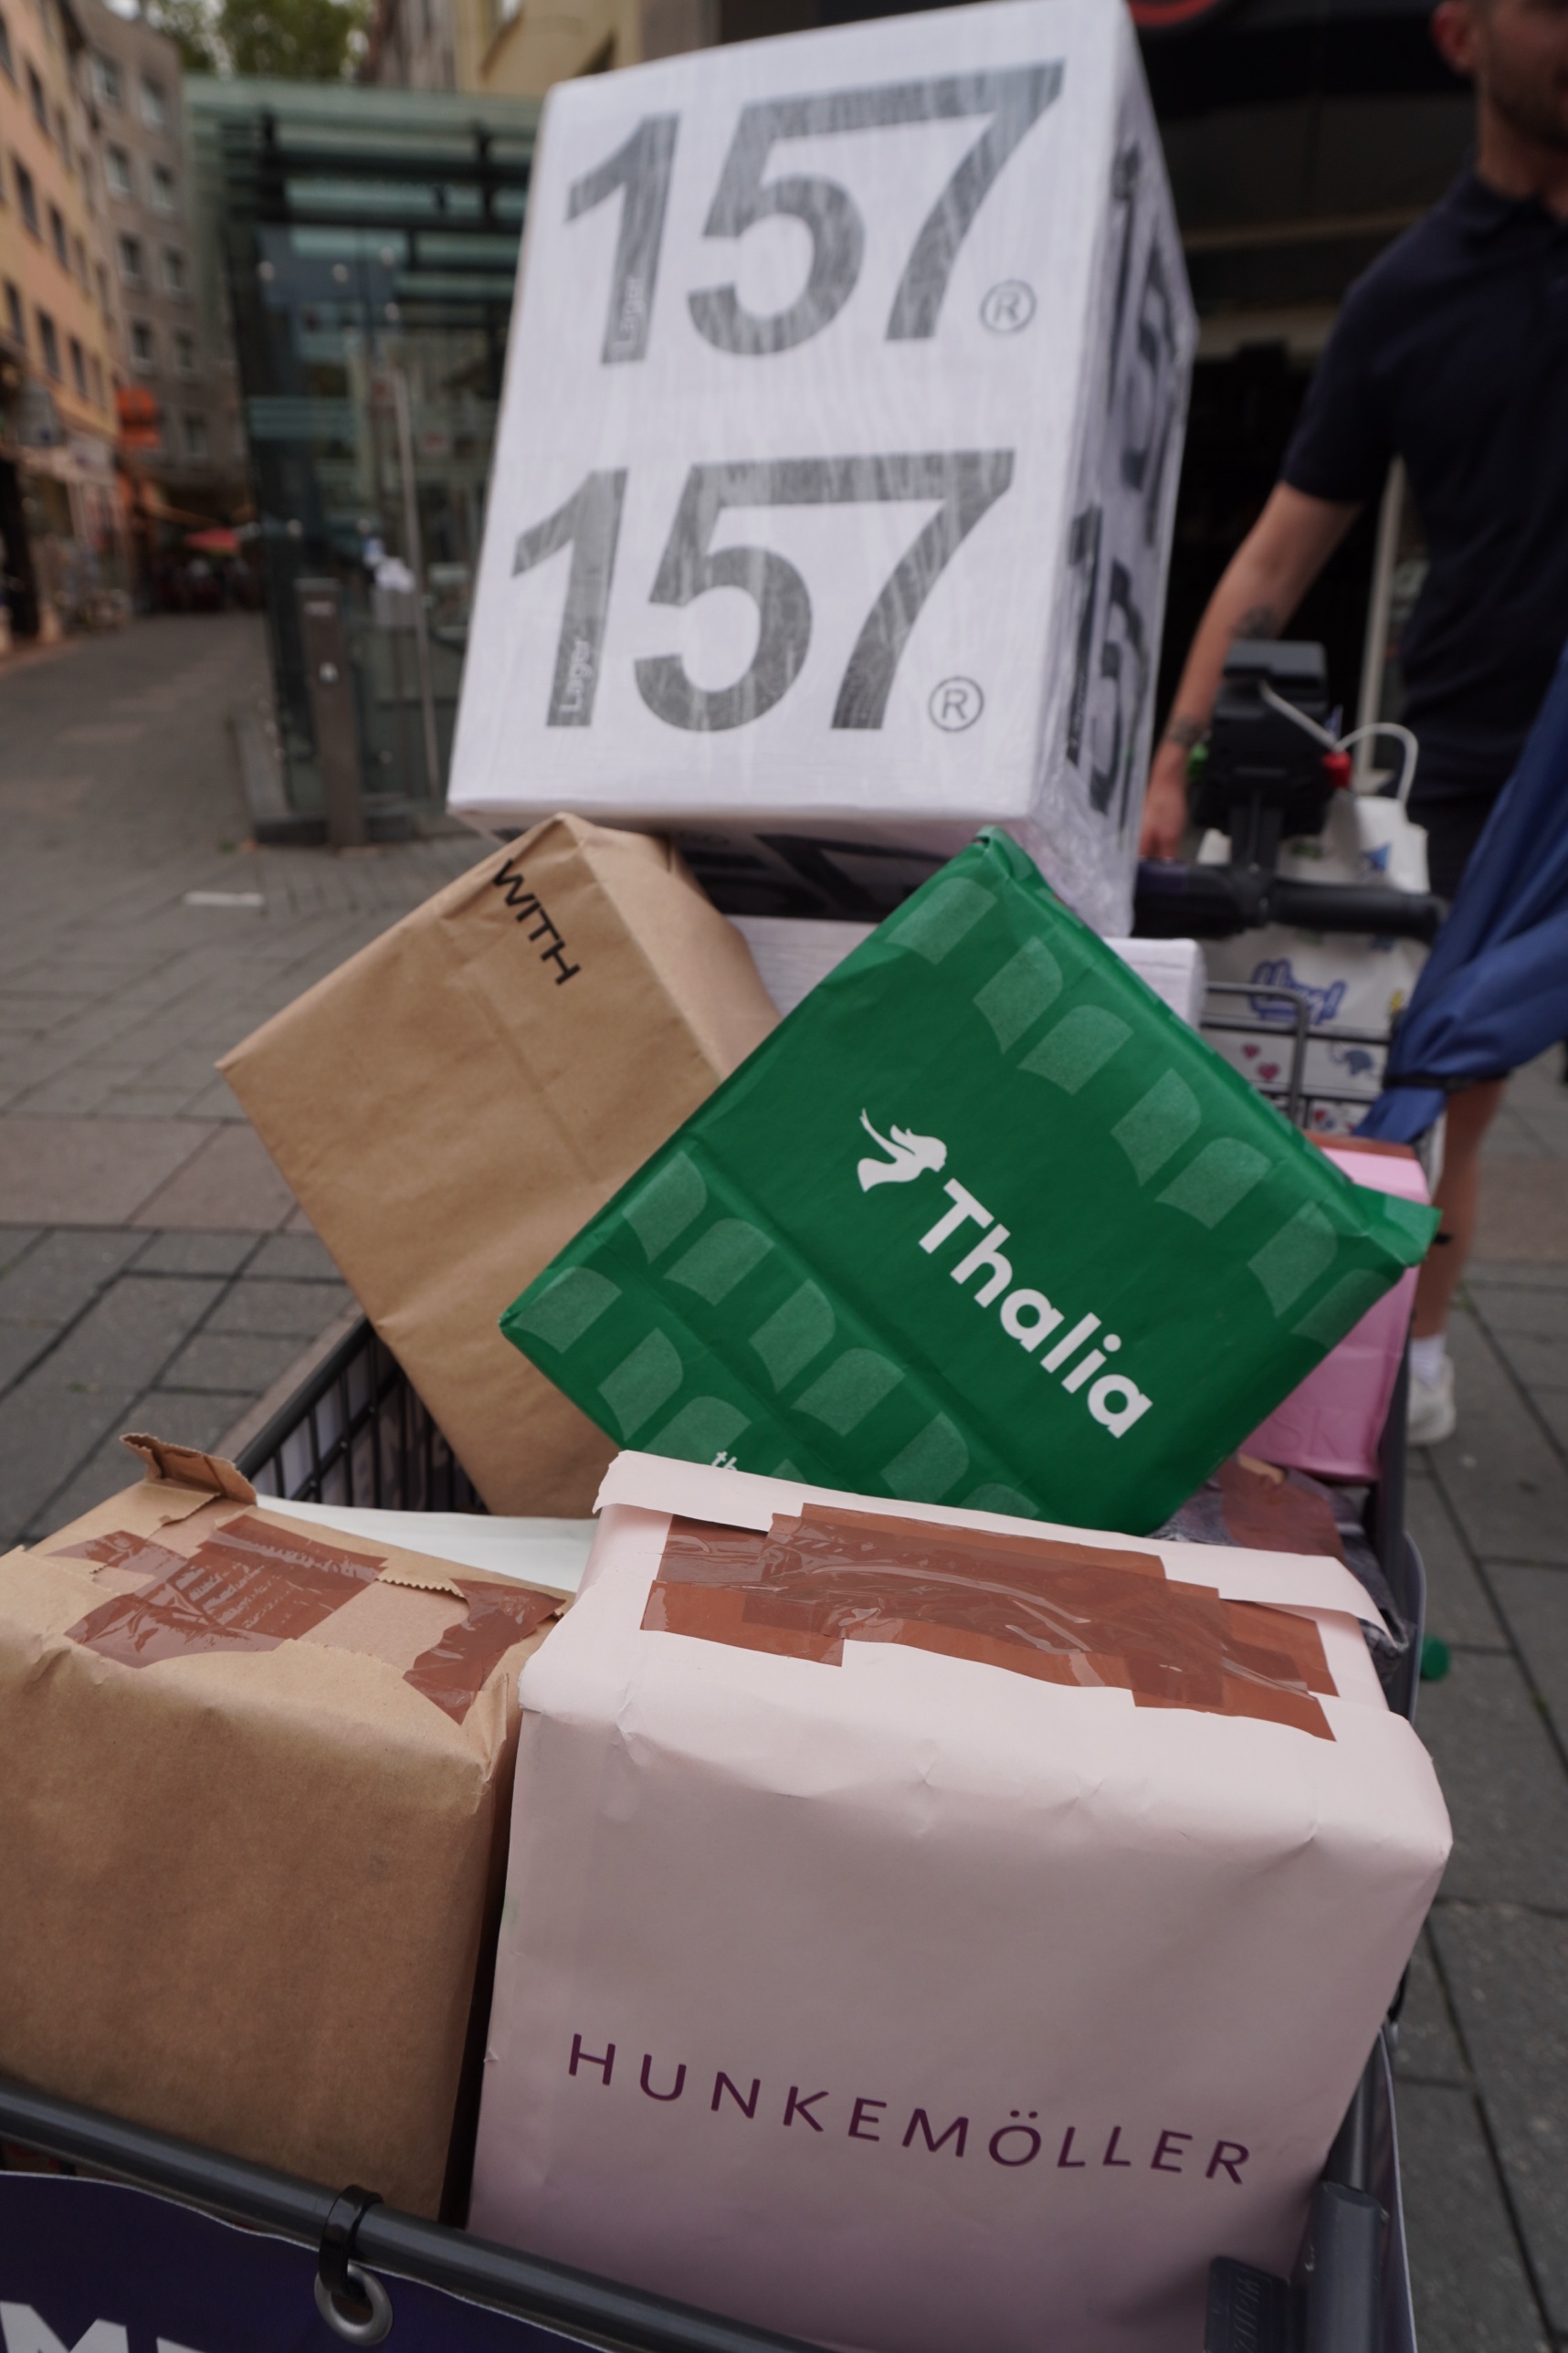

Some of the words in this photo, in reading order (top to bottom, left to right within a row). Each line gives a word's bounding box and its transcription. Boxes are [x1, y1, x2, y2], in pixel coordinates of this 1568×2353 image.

[564, 58, 1066, 365] 157
[510, 448, 1016, 733] 157
[490, 857, 582, 987] WITH
[918, 1177, 1154, 1440] Thalia
[567, 2032, 1251, 2186] HUNKEMÖLLER
